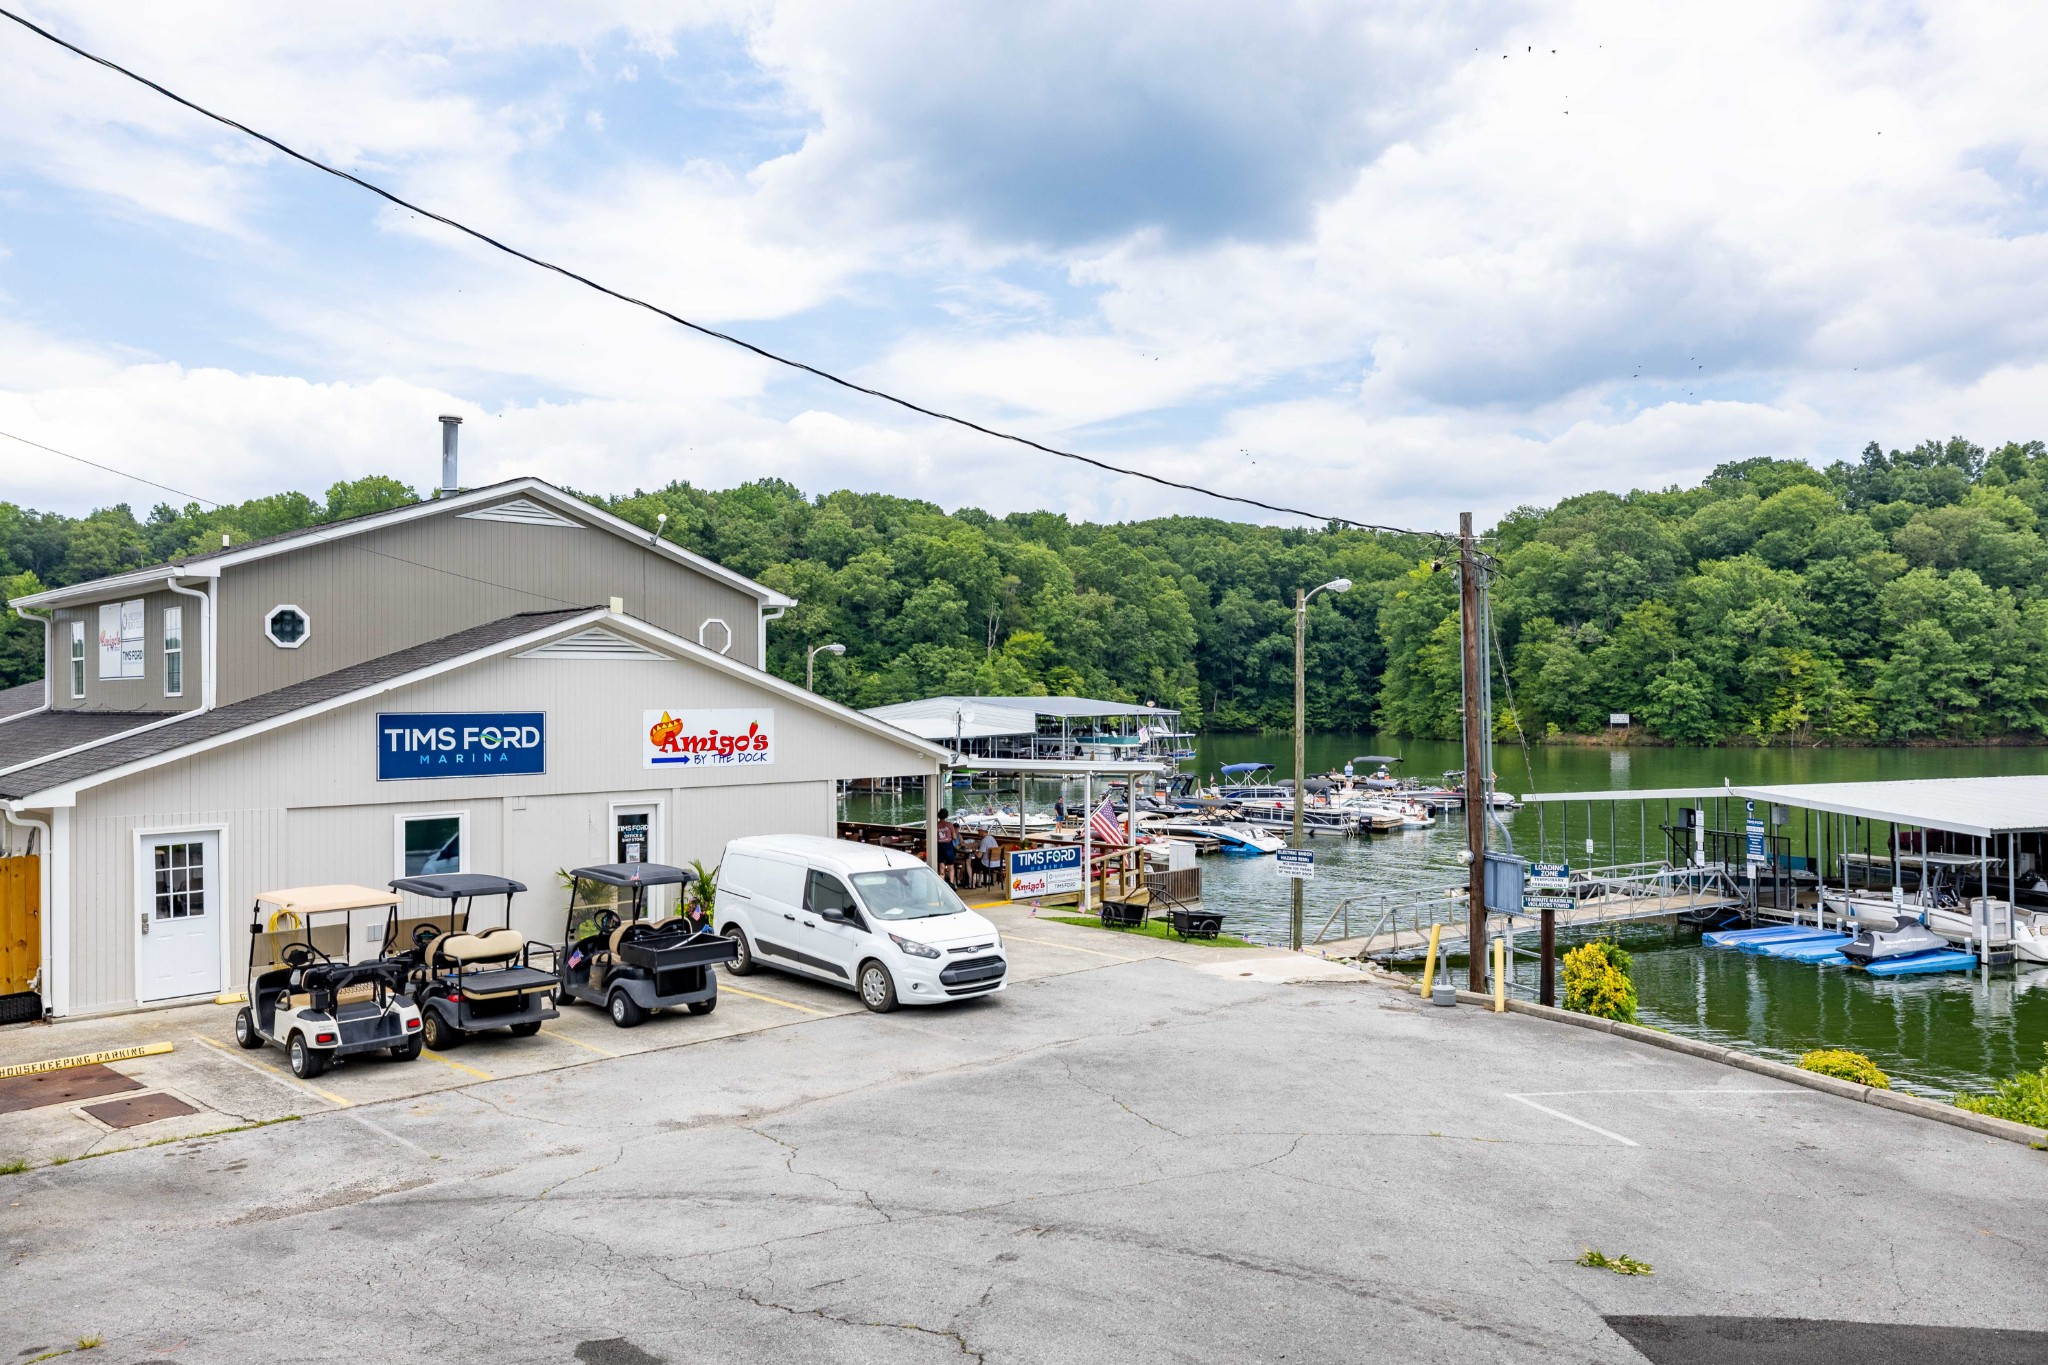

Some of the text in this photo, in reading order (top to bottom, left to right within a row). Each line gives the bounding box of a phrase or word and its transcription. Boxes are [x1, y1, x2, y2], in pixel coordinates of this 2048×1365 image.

[384, 726, 540, 752] TIMS FORD
[659, 720, 769, 757] Amigo's
[420, 753, 508, 764] MARINA
[694, 752, 767, 764] BY THE DOCK
[1746, 802, 1754, 811] C
[1018, 849, 1076, 866] TIMS FORD
[1030, 863, 1063, 871] MARINA
[1015, 878, 1045, 891] Amigo's
[0, 1046, 145, 1077] HOUSEKEEPING PARKING
